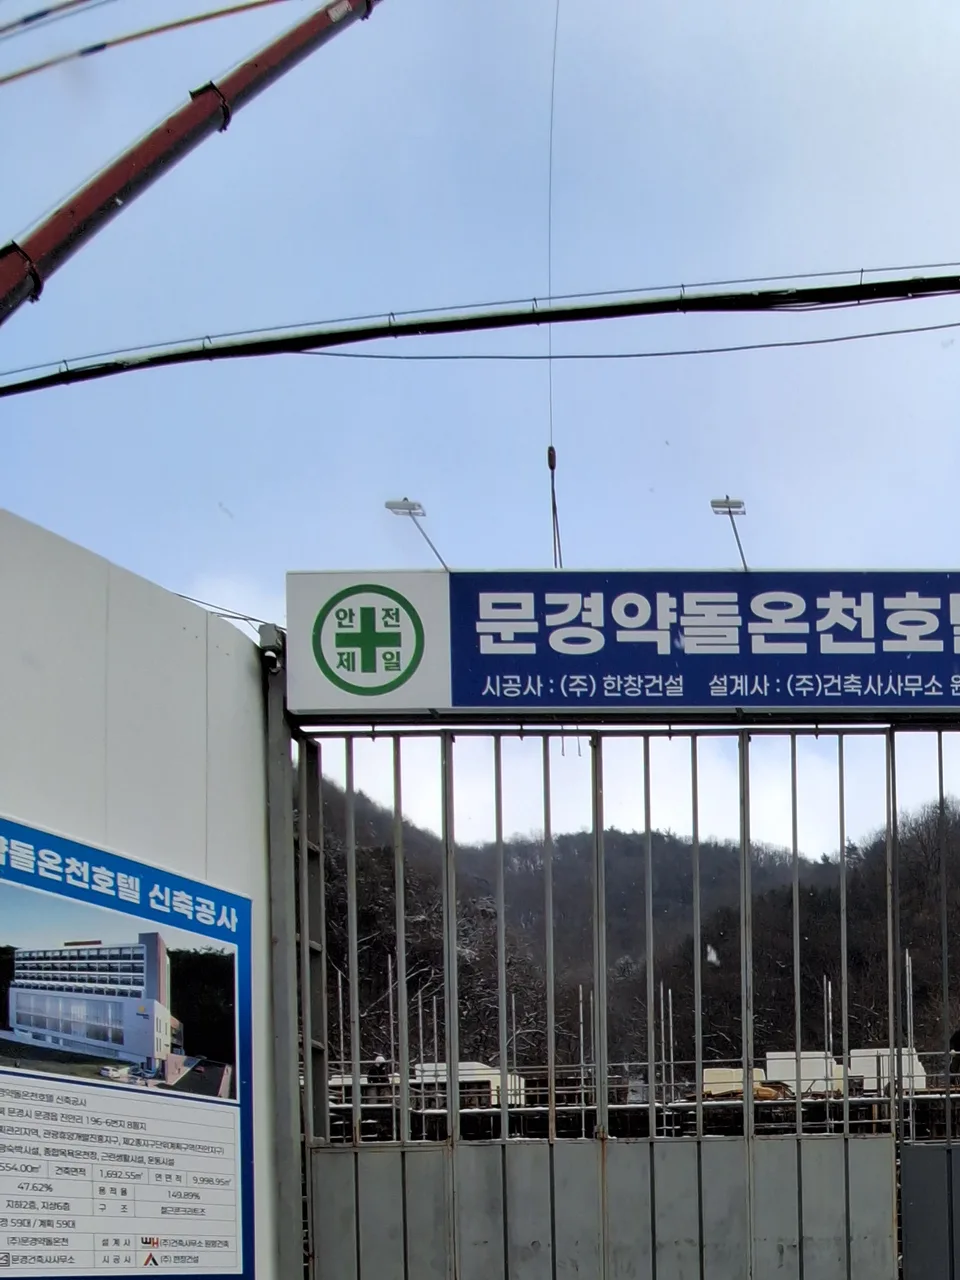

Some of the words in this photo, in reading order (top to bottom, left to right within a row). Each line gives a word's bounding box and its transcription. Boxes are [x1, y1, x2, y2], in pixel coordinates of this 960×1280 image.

[482, 674, 543, 698] 시공사
[560, 674, 597, 698] (주)
[603, 674, 684, 698] 한창건설
[708, 673, 770, 697] 설계사
[787, 673, 944, 697] (주)건축사사무소
[149, 883, 239, 933] 신축공사
[17, 1182, 53, 1193] 47.62%
